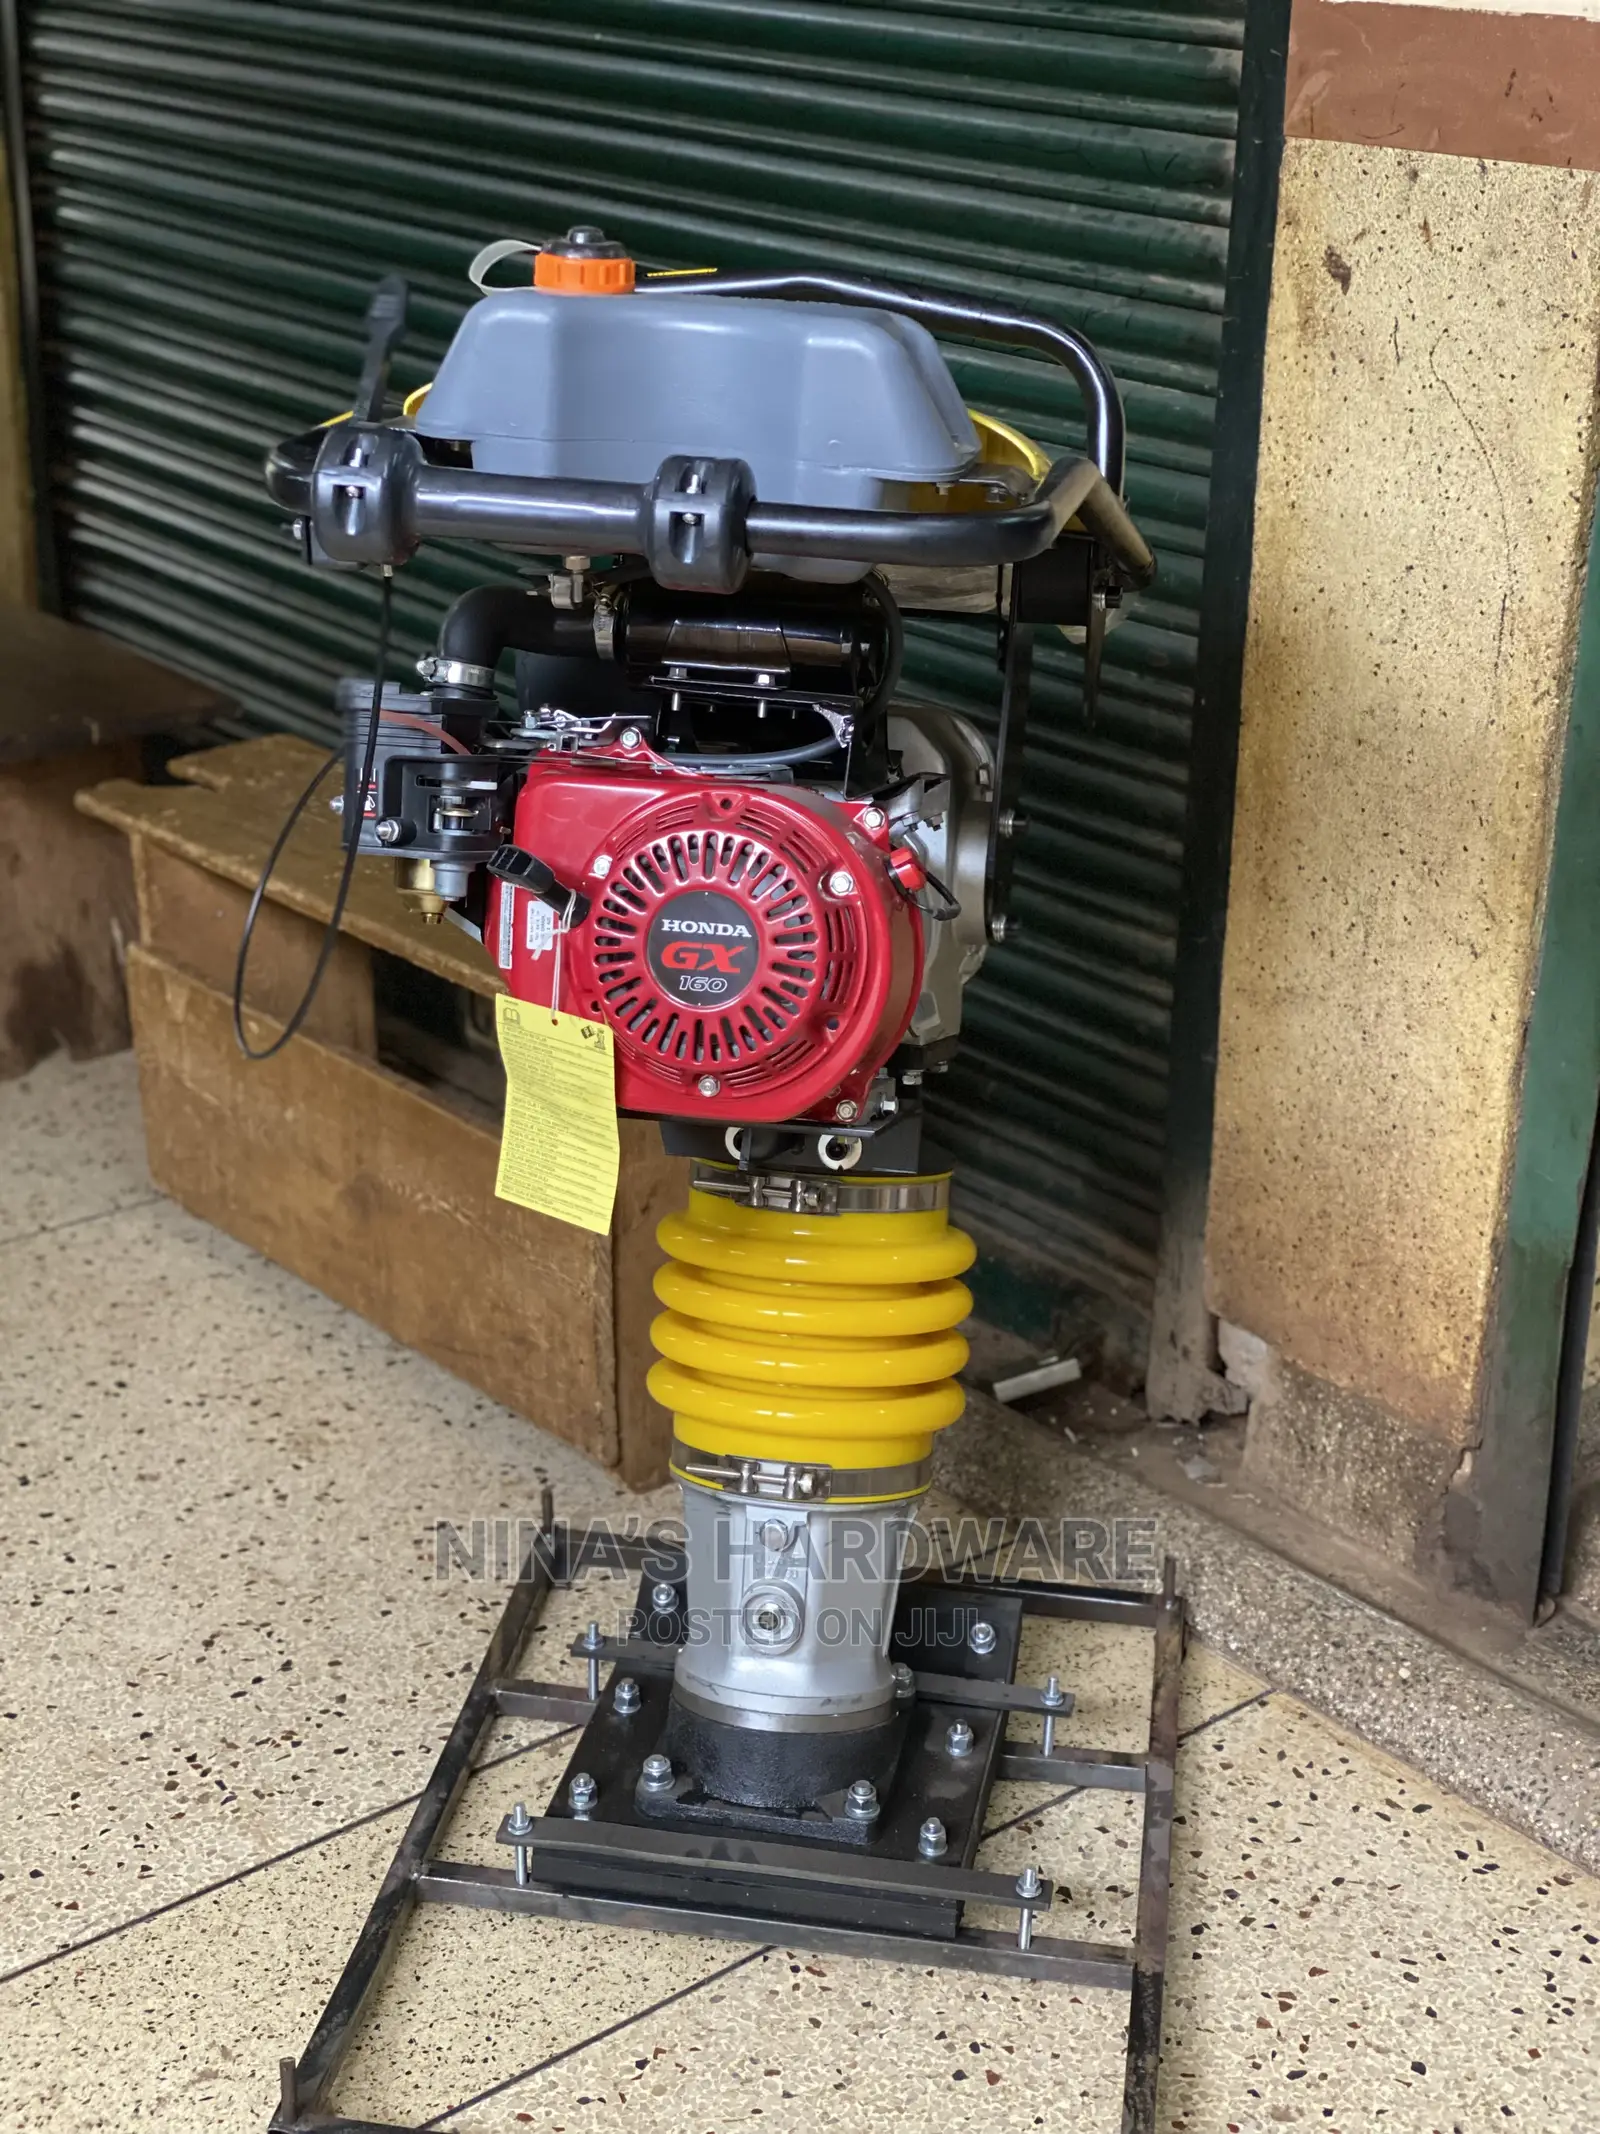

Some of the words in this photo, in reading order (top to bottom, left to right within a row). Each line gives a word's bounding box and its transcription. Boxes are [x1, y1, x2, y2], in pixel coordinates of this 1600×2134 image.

[661, 919, 752, 938] HONDA
[661, 941, 748, 973] GX
[679, 975, 728, 993] 160
